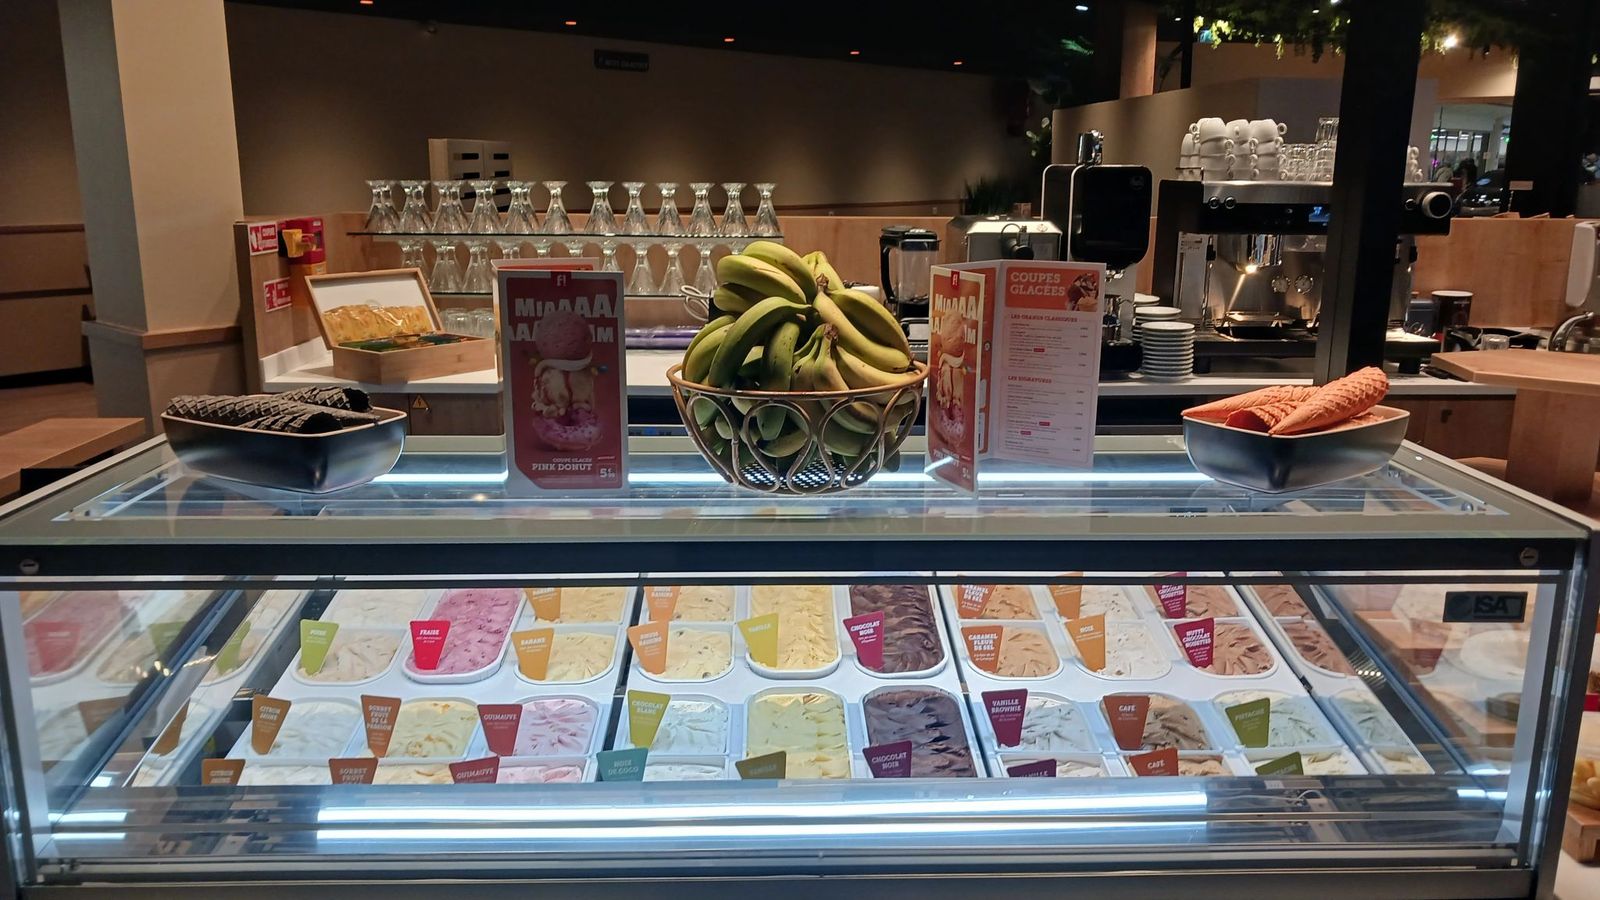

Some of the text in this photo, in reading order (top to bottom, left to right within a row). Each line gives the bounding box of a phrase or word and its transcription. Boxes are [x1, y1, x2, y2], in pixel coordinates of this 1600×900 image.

[1010, 271, 1061, 283] COUPES
[1010, 284, 1066, 296] GLACÉES
[531, 463, 593, 471] PINK DONUT
[850, 620, 881, 632] CHOCOLAT
[968, 633, 998, 641] CARAMEL
[1182, 633, 1211, 643] CHOCOLAT
[991, 698, 1020, 707] VANILLE
[368, 704, 392, 713] SORBET
[991, 705, 1022, 714] BROWNIE
[483, 713, 518, 721] GUIMAUVE
[871, 752, 908, 764] CHOCOLAT
[881, 761, 900, 770] NOIR
[456, 767, 494, 779] GUIMAUVE
